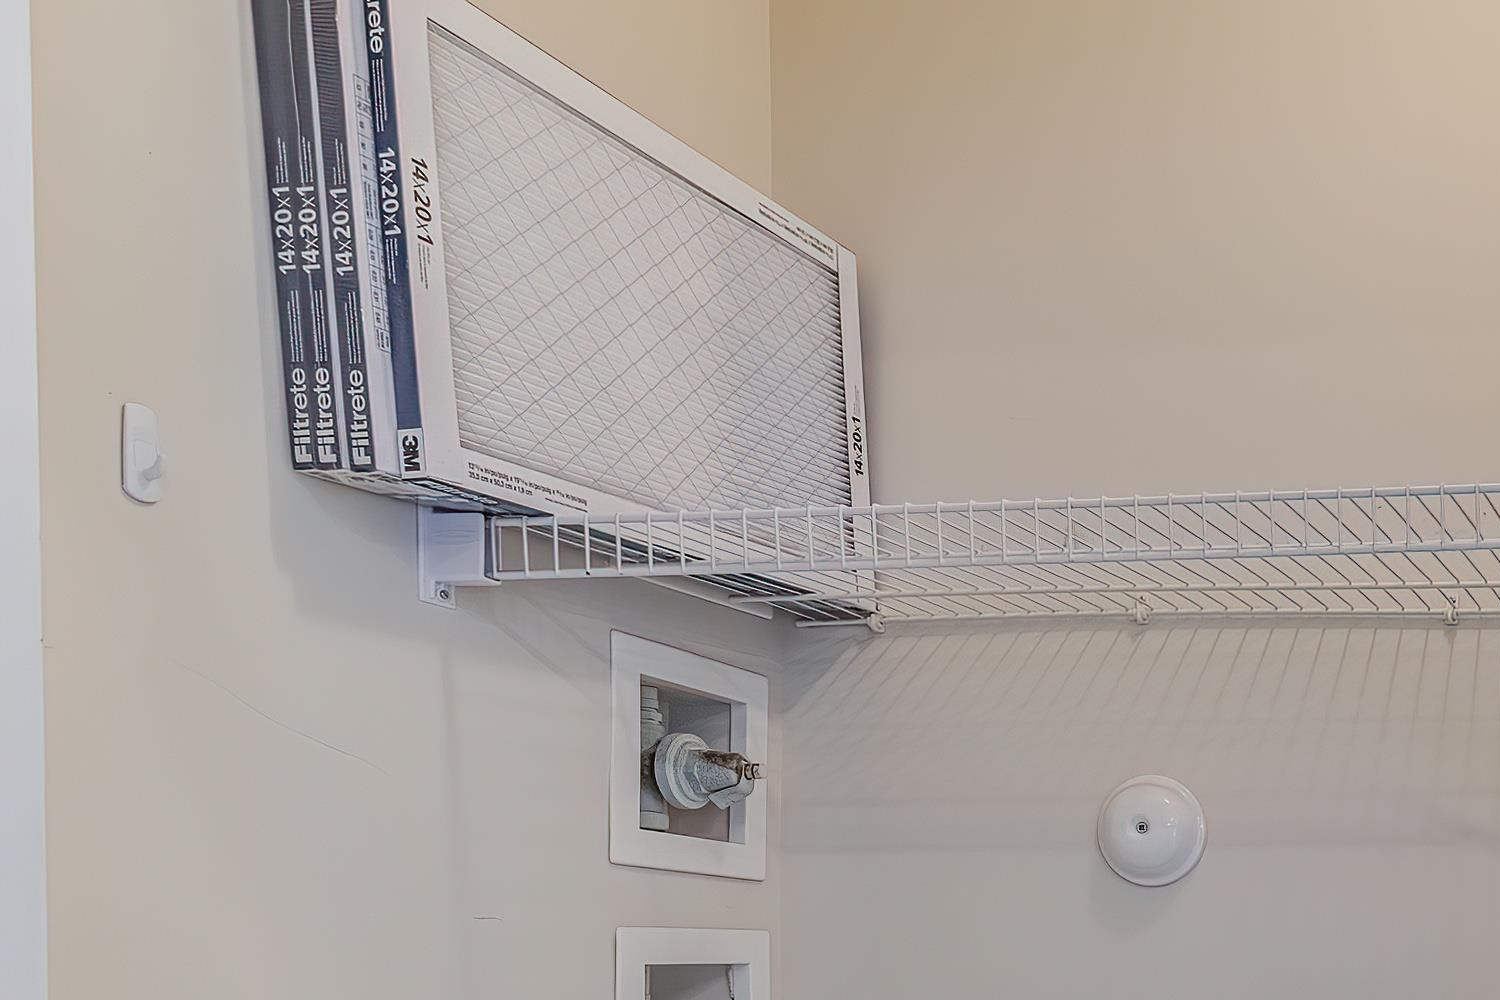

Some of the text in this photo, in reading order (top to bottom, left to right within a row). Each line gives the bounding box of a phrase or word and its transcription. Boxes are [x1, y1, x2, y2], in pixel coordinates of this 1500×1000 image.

[367, 0, 385, 53] rete
[290, 368, 313, 463] Filtrete
[313, 367, 337, 463] Filtrete
[347, 369, 372, 465] Filtrete
[402, 434, 421, 473] 3M
